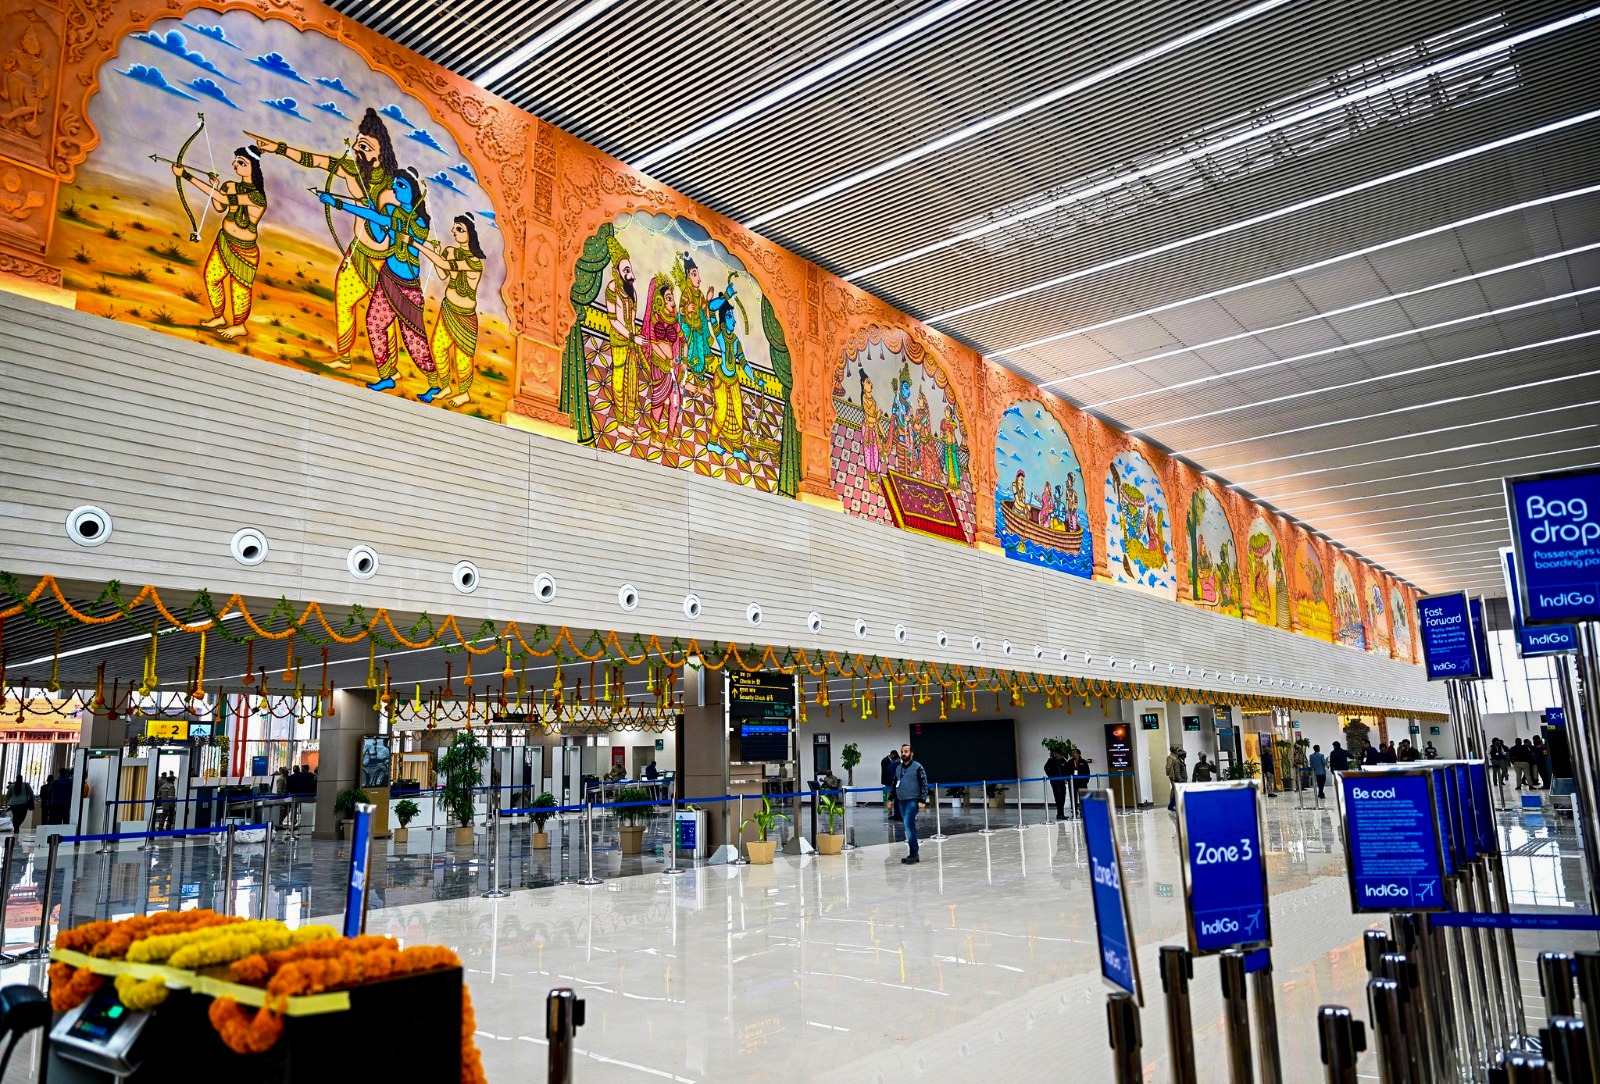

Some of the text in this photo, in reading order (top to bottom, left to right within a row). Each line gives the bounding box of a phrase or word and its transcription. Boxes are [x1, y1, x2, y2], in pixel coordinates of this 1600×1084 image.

[1526, 495, 1588, 521] Bag
[1530, 520, 1600, 546] drop
[1534, 548, 1594, 559] Passengers
[1535, 558, 1583, 568] boarding
[1540, 592, 1595, 608] IndiGo
[1424, 607, 1443, 618] Fast
[1426, 613, 1462, 626] Forward
[1528, 633, 1569, 646] IndiGo
[1433, 661, 1456, 670] IndiGo
[172, 725, 179, 734] 2
[1352, 787, 1396, 799] Be cool
[1195, 838, 1253, 865] Zone 3
[1092, 857, 1113, 888] Zone
[1365, 883, 1409, 897] IndiGo
[1201, 917, 1239, 935] IndiGo
